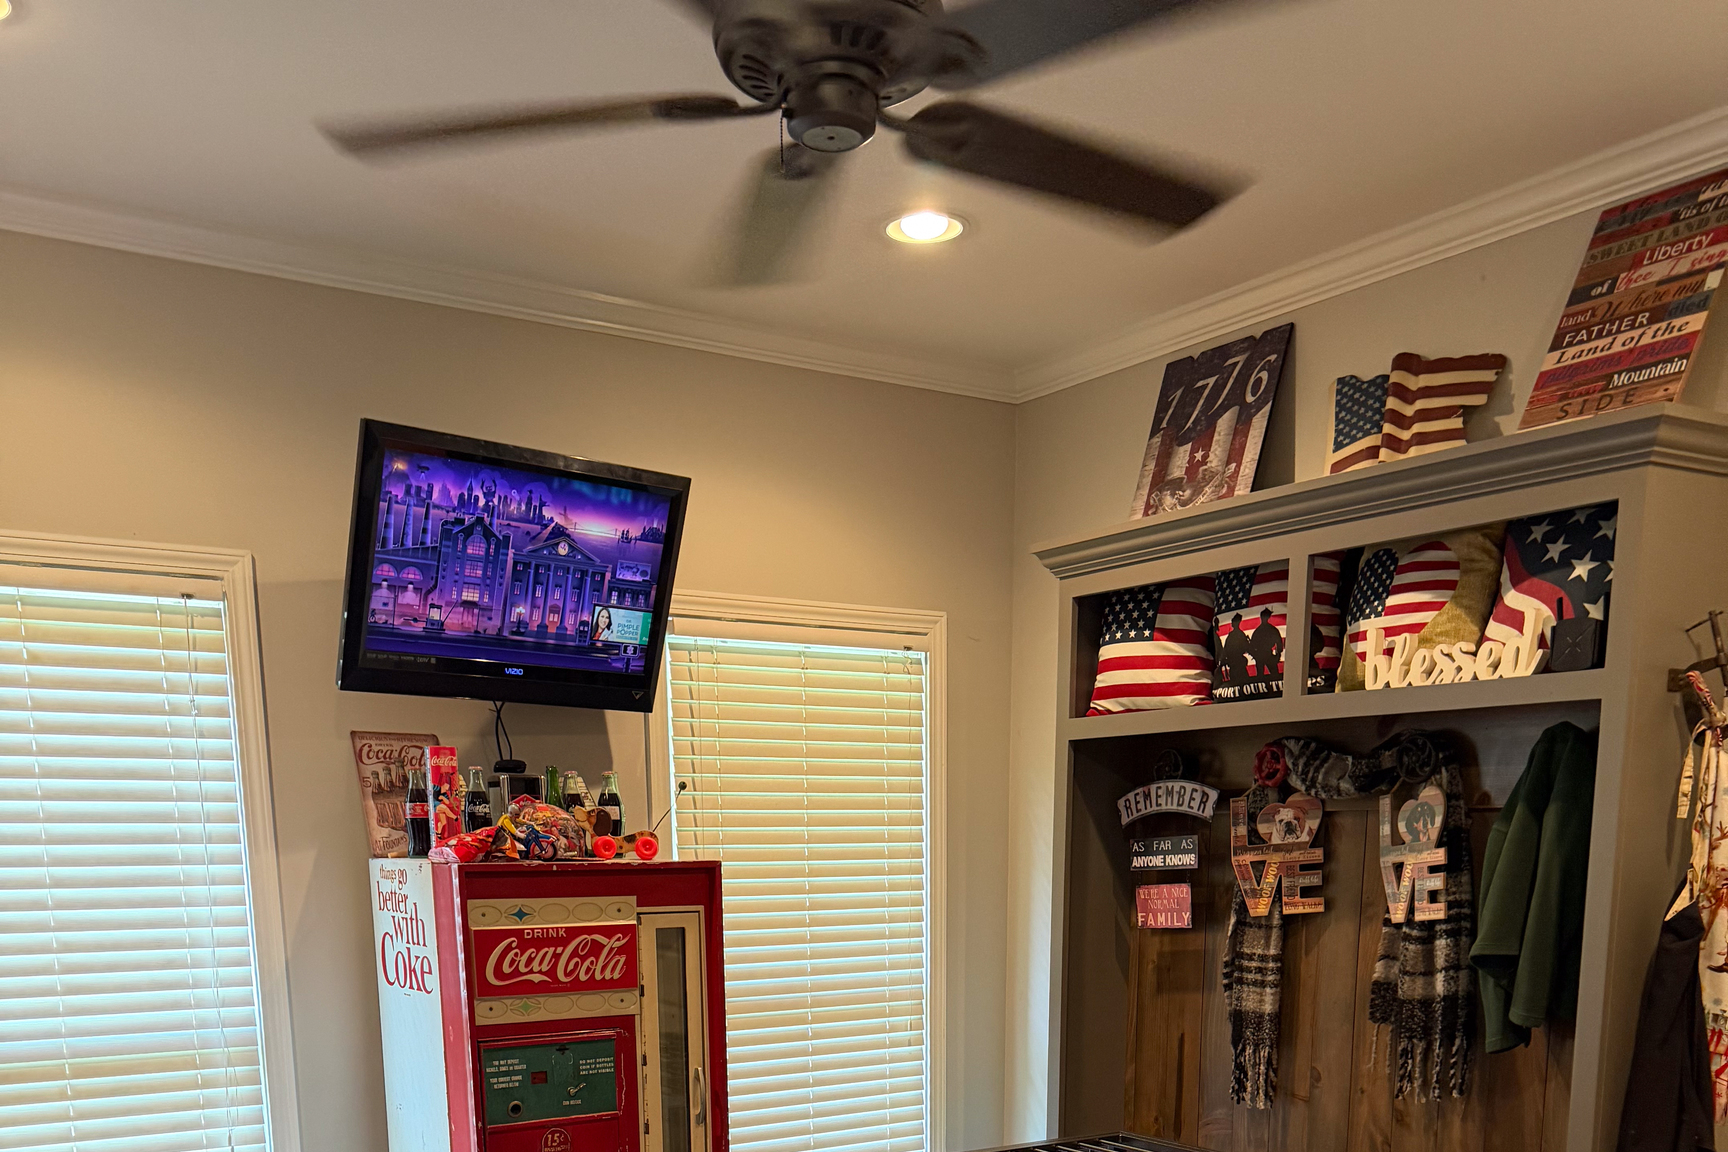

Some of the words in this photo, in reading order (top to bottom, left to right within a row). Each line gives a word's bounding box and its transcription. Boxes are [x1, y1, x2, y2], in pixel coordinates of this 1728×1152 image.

[1642, 232, 1714, 265] Liberty
[1590, 279, 1612, 297] of
[1615, 269, 1656, 292] thee
[1560, 310, 1592, 328] land
[1592, 288, 1668, 321] Where
[1672, 278, 1706, 298] my
[1562, 311, 1651, 347] FATHER
[1667, 294, 1708, 318] died
[1553, 336, 1618, 366] Land
[1620, 326, 1652, 348] of
[1650, 320, 1690, 341] the
[1608, 357, 1688, 389] Mountain
[1159, 353, 1279, 436] 1776
[1555, 386, 1640, 421] SIDE
[616, 629, 639, 637] POPPER
[617, 623, 641, 632] PIMPLE
[1364, 607, 1540, 691] blessed
[504, 667, 524, 676] VIZIO
[1243, 682, 1268, 695] OUR
[357, 742, 427, 768] Coca-Col
[362, 777, 372, 788] 5
[1123, 785, 1210, 819] REMEMBER
[1132, 840, 1145, 852] AS
[1153, 839, 1172, 851] FAR
[1180, 838, 1194, 850] AS
[1132, 855, 1165, 867] ANYONE
[1165, 854, 1196, 866] KNOWS
[379, 864, 397, 883] things
[397, 868, 408, 891] go
[377, 881, 409, 915] better
[1147, 899, 1180, 910] NORMAL
[1162, 888, 1169, 898] A
[1171, 887, 1189, 898] NICE
[391, 902, 428, 948] with
[523, 927, 567, 939] DRINK
[1137, 911, 1191, 927] FAMILY
[381, 931, 434, 995] Coke
[485, 932, 632, 987] Coca-Cola
